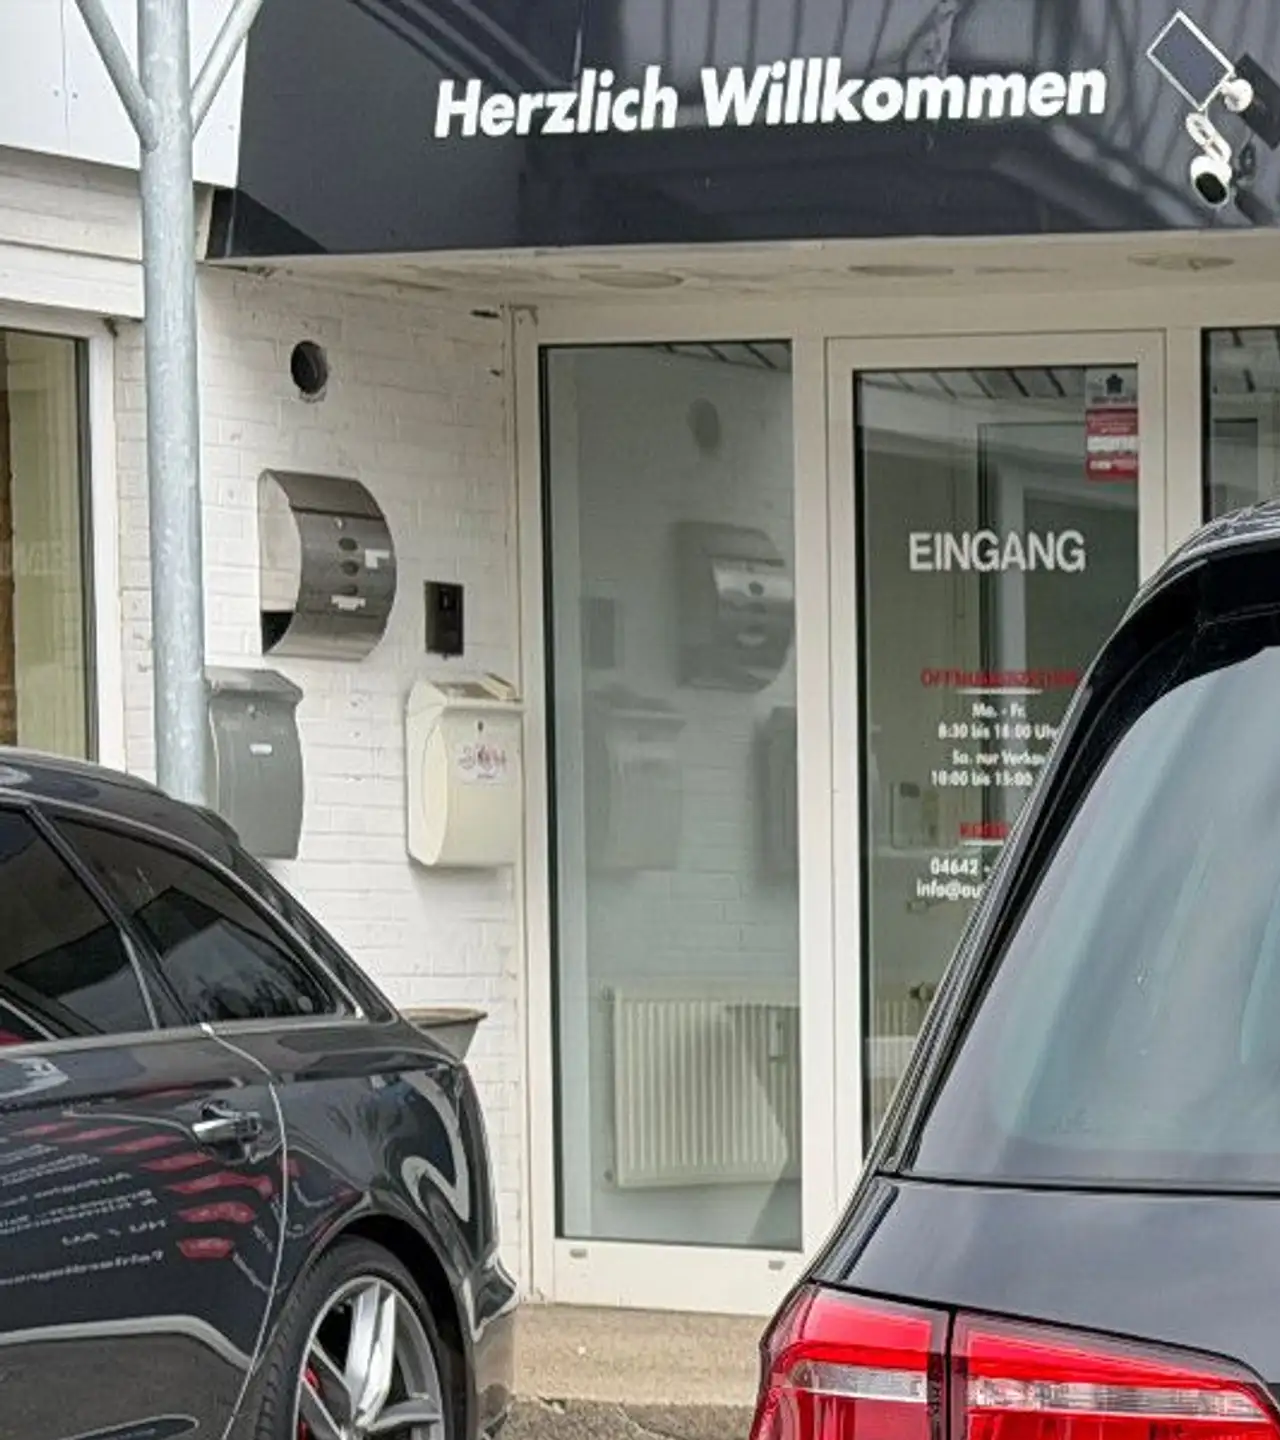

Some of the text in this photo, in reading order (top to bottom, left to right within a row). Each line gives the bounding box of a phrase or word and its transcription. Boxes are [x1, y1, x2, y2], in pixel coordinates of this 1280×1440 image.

[434, 57, 1107, 139] Herzlich Willkommen
[909, 529, 1086, 573] EINGANG
[930, 857, 978, 876] 04642
